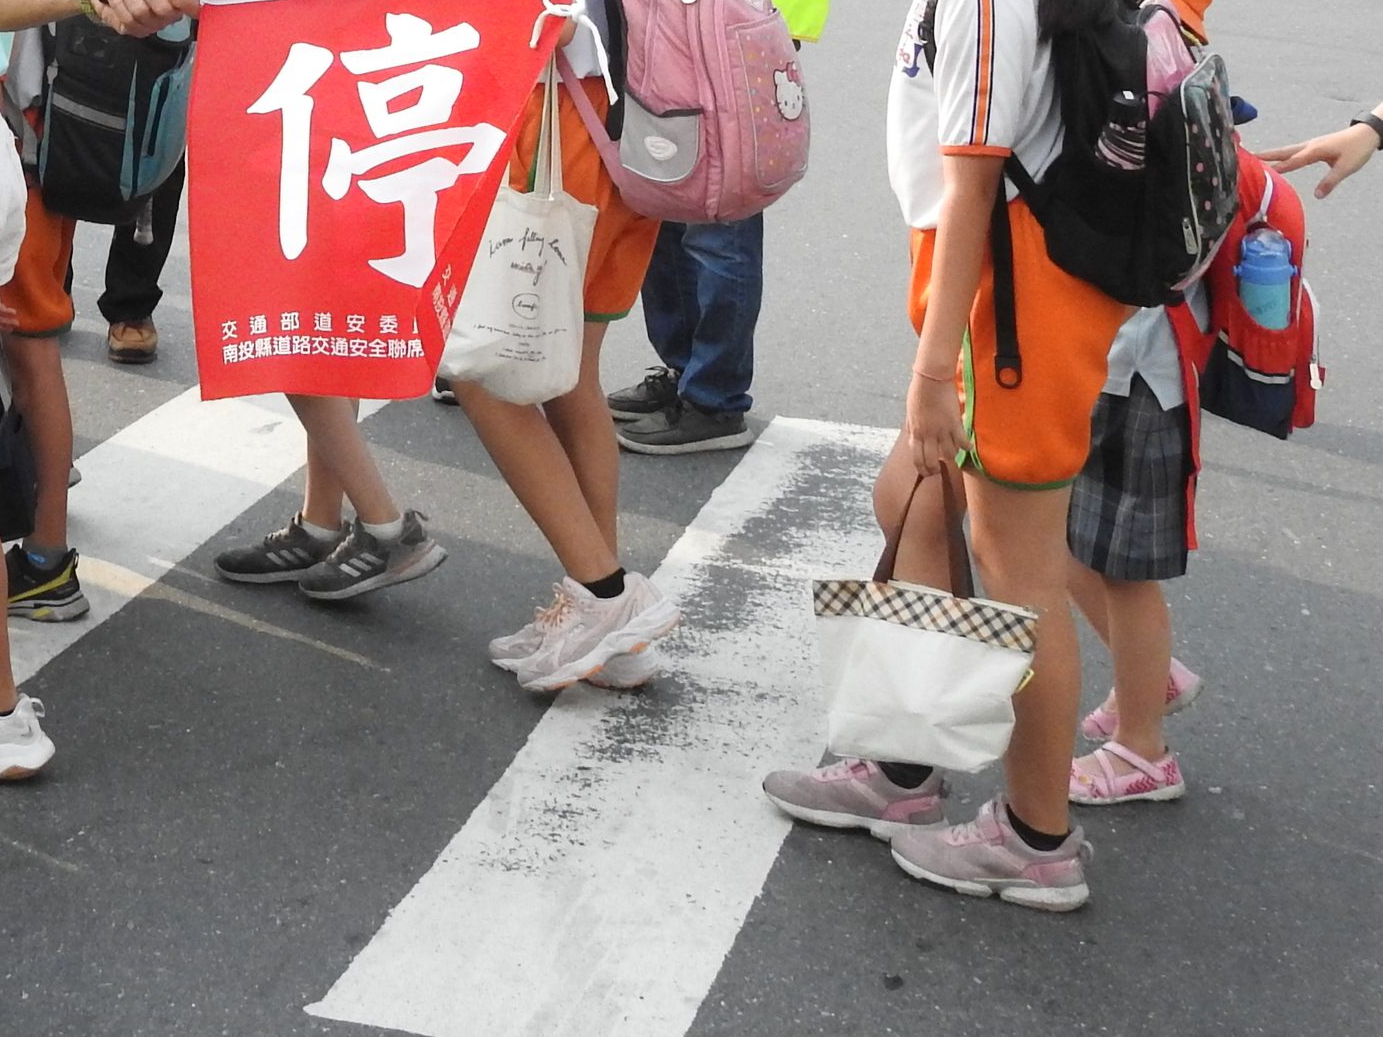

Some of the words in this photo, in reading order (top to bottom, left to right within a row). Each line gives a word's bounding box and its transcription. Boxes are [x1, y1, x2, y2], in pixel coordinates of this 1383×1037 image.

[246, 12, 508, 288] 停
[222, 311, 418, 340] 交通部道安委
